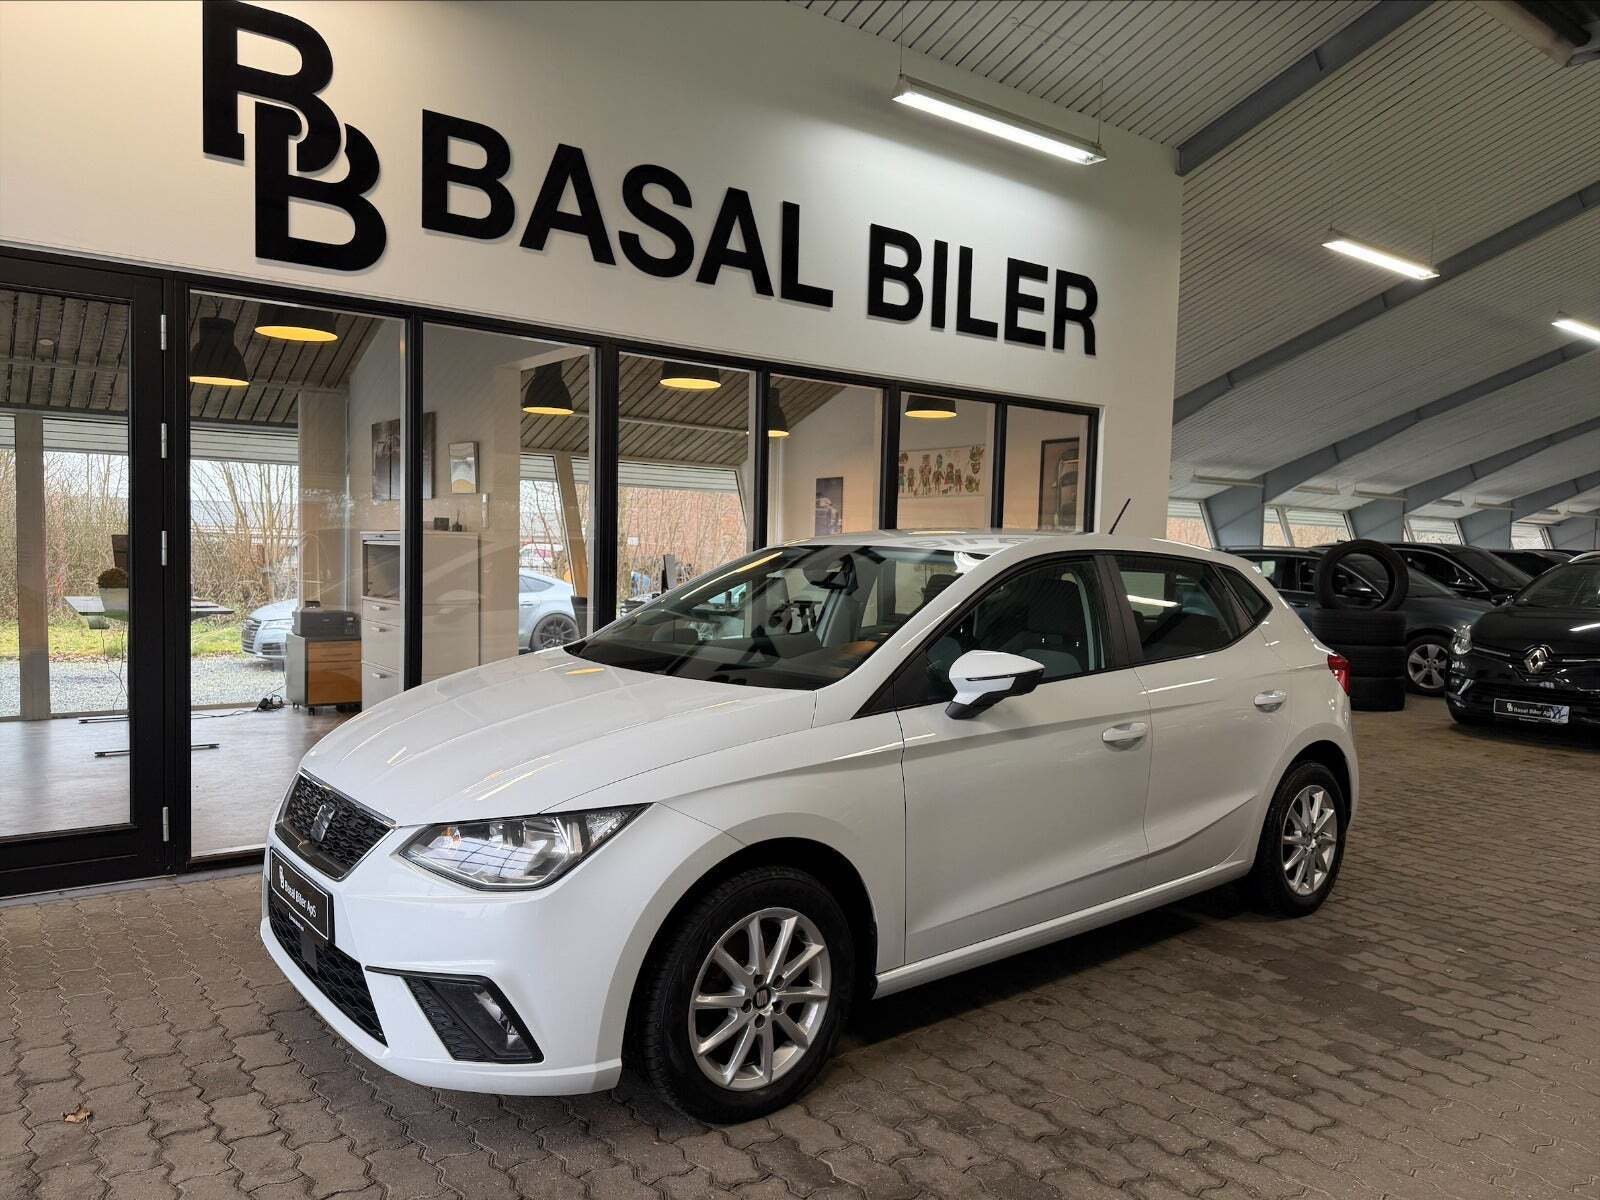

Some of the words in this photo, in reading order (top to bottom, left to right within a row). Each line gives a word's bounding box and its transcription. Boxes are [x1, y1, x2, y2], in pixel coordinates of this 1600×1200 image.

[422, 108, 833, 308] BASAL
[867, 223, 1098, 356] BILER
[285, 880, 296, 900] Basal
[296, 890, 307, 908] Biler
[307, 900, 317, 918] ApS
